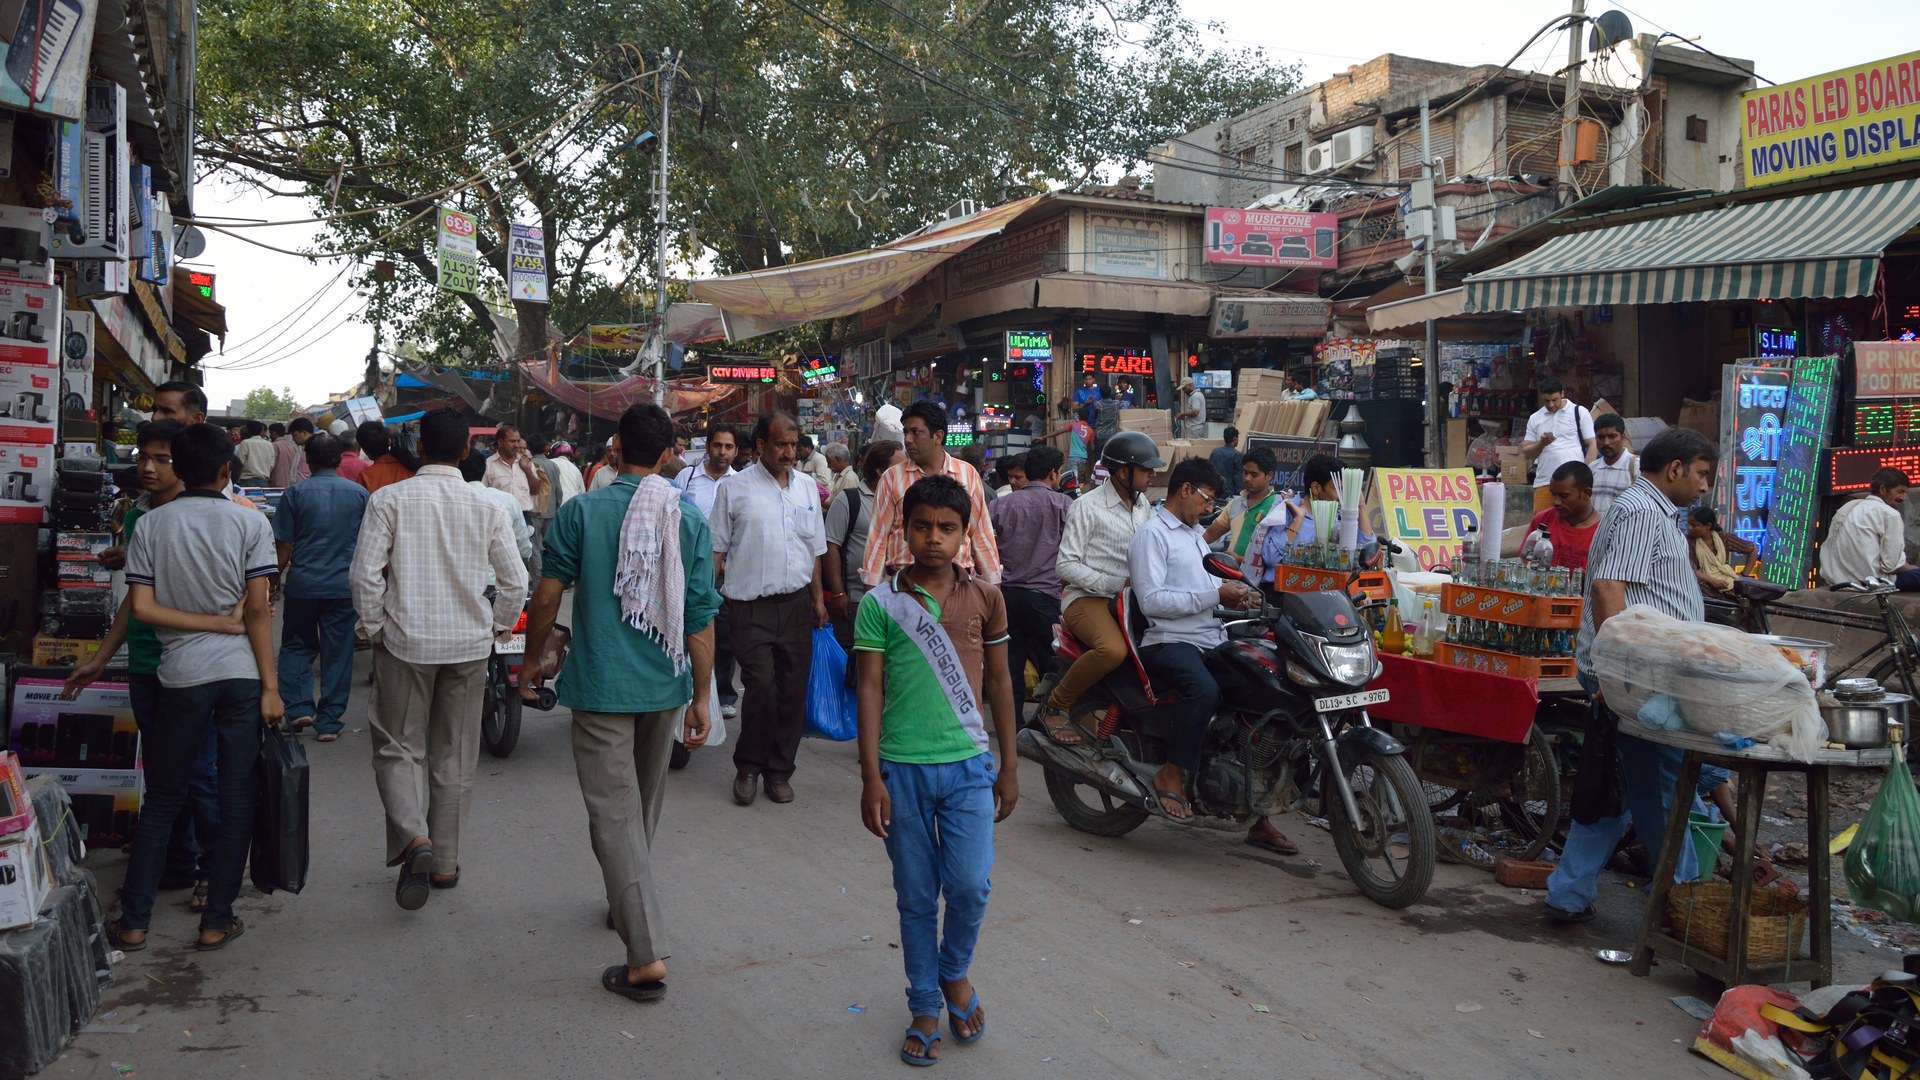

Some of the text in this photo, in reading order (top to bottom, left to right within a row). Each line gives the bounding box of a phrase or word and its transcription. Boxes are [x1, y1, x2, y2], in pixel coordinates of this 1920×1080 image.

[1746, 86, 1808, 139] PARAS
[1811, 76, 1850, 126] LED
[1751, 132, 1837, 178] MOVING
[445, 214, 473, 233] 639
[1245, 213, 1312, 227] MUSICTONE
[513, 262, 545, 271] CCTV
[514, 255, 541, 263] DVR
[443, 260, 475, 275] CCTV
[1279, 303, 1328, 317] ENTERPRISES
[1010, 335, 1049, 348] ULTIMA
[712, 367, 731, 378] CCTV
[732, 367, 759, 378] DIVINE
[1100, 355, 1154, 374] CARD
[1739, 374, 1788, 409] होटल
[1080, 424, 1089, 438] 5
[1740, 412, 1783, 461] श्री
[1387, 474, 1473, 502] PARAS
[1736, 466, 1778, 510] राम
[1394, 506, 1480, 539] LED
[1455, 591, 1476, 608] Crush
[1478, 595, 1500, 611] Crush
[1502, 599, 1525, 615] Crush
[25, 692, 52, 701] MOVIE
[1368, 691, 1387, 702] 9767
